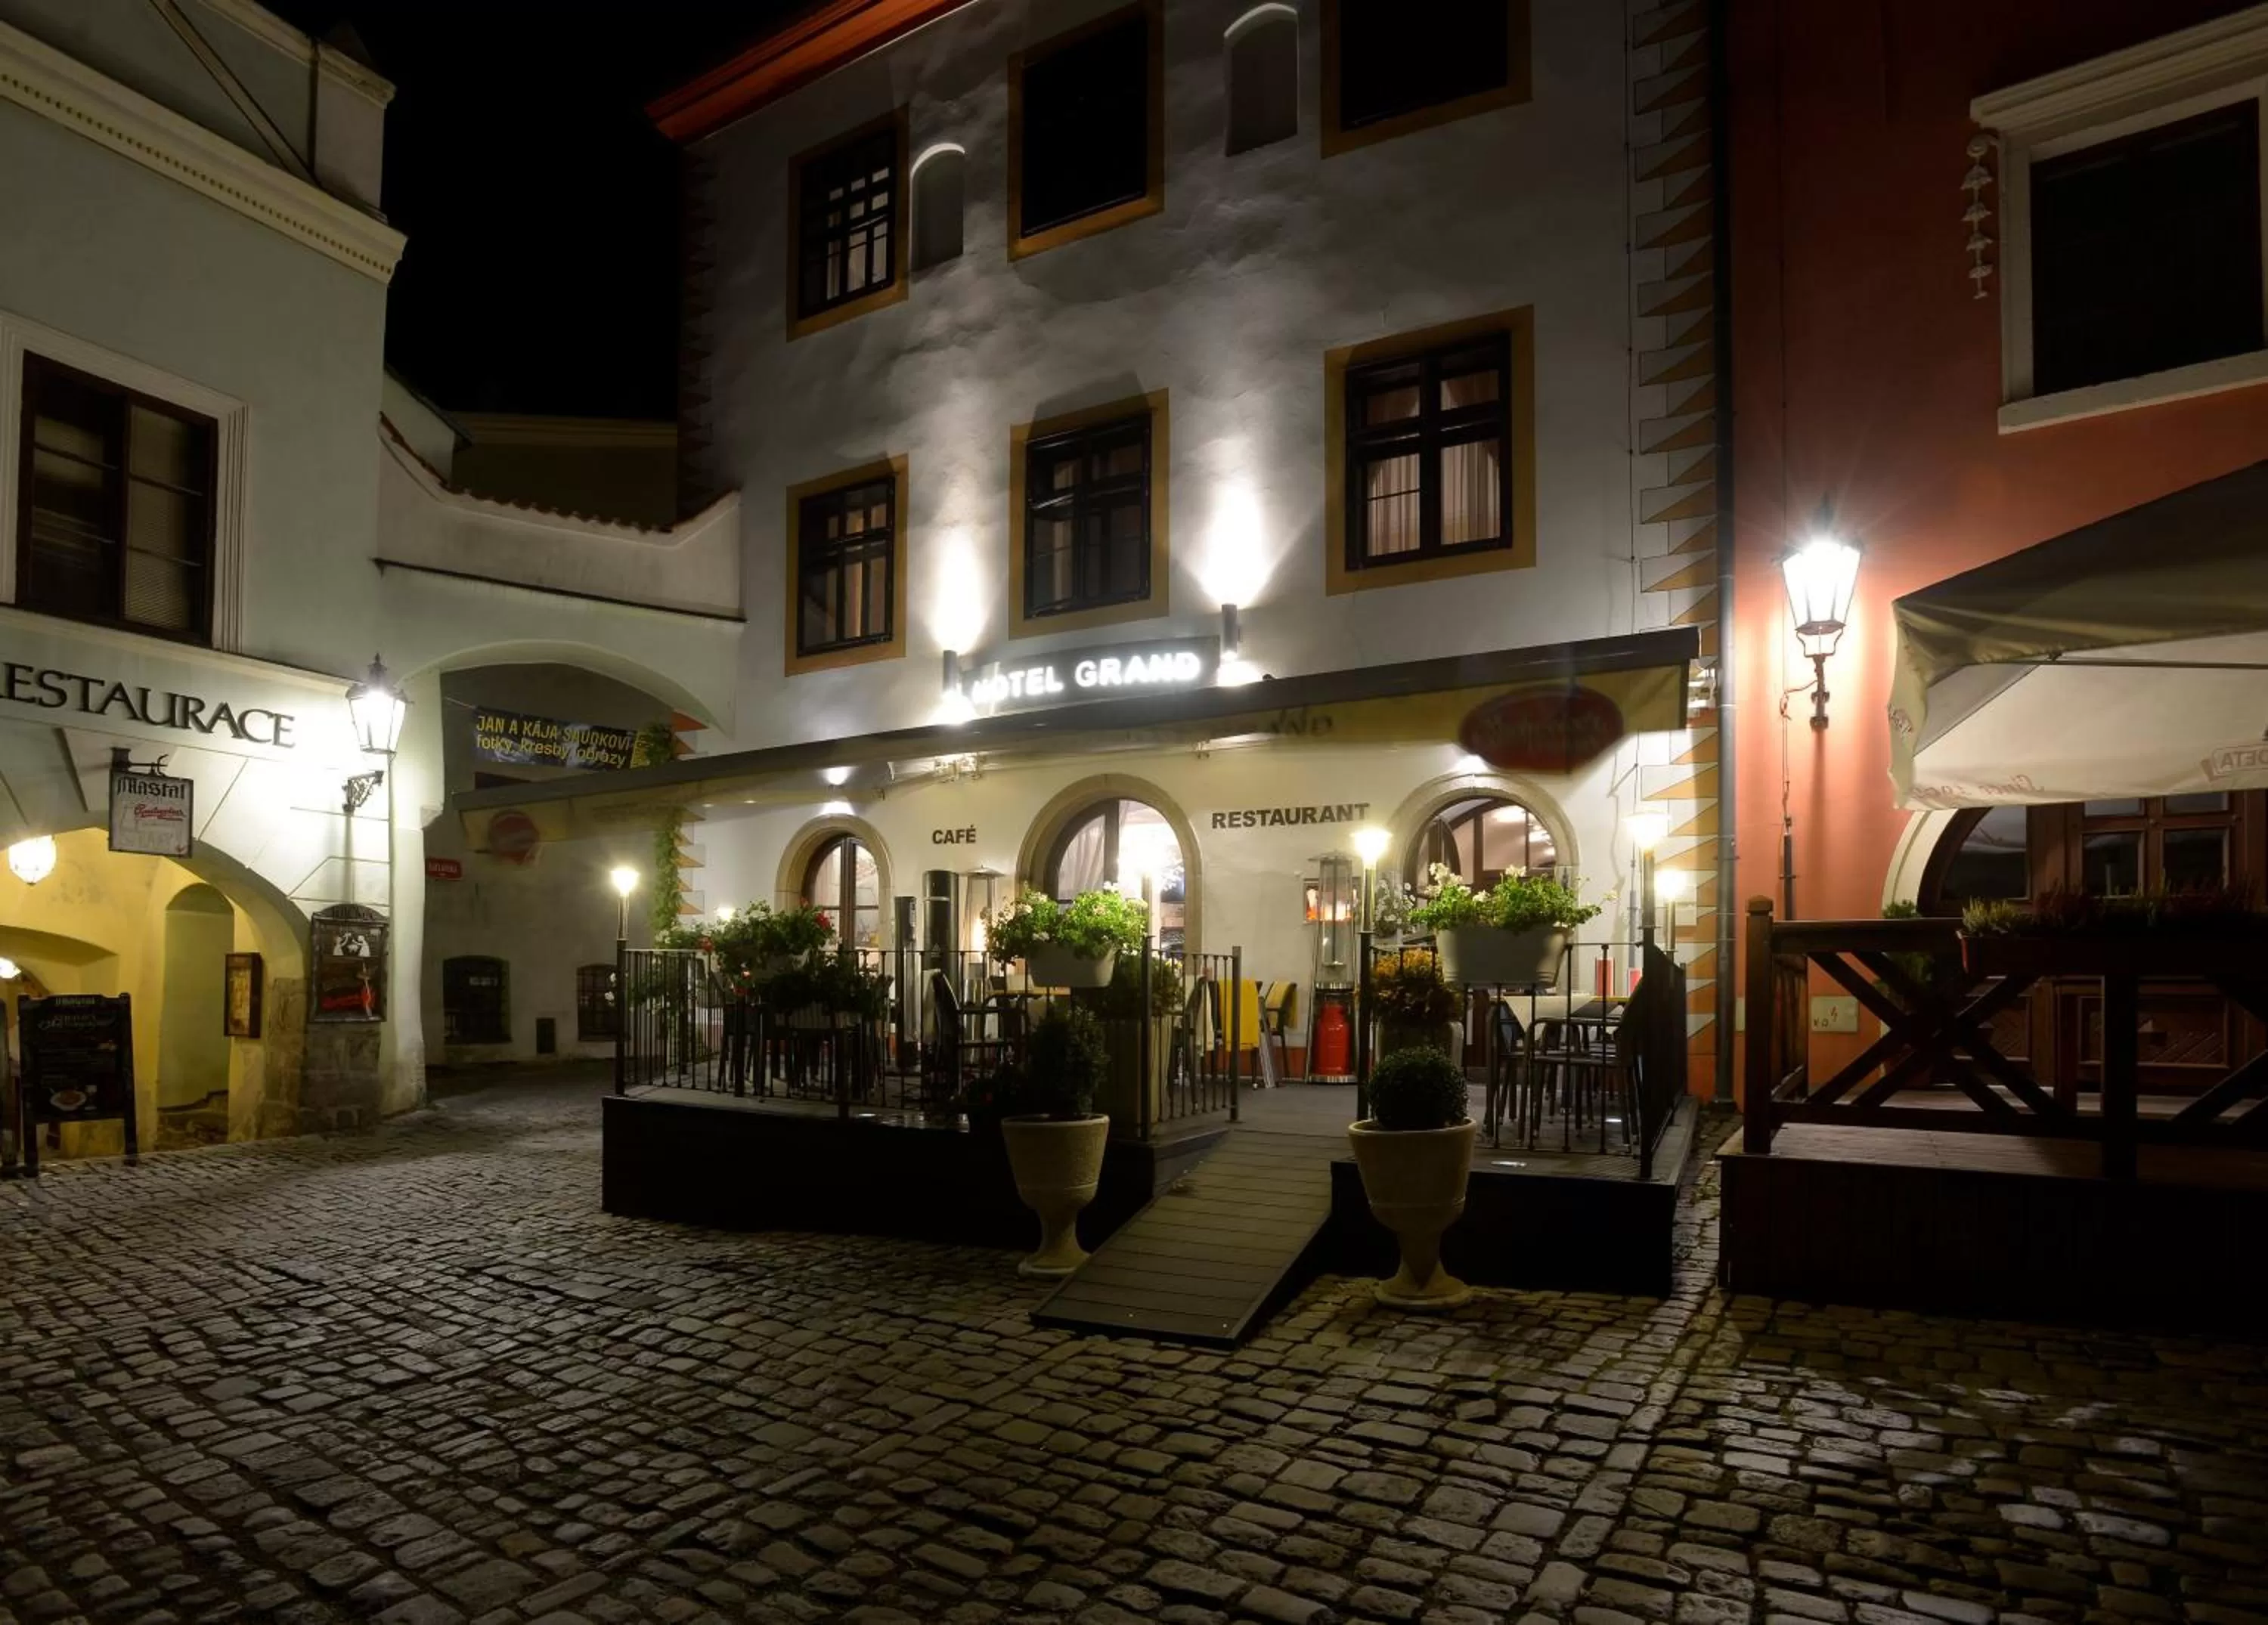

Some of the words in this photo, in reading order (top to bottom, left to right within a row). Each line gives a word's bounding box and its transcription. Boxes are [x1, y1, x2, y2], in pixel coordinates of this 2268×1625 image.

[972, 666, 1064, 704] HOTEL
[1075, 652, 1201, 687] GRAND
[0, 662, 296, 748] ESTAURACE
[476, 716, 504, 733] JAN
[508, 719, 519, 735] A
[522, 720, 557, 739] KÁJA
[1212, 803, 1370, 828] RESTAURANT
[932, 825, 976, 844] CAFÉ
